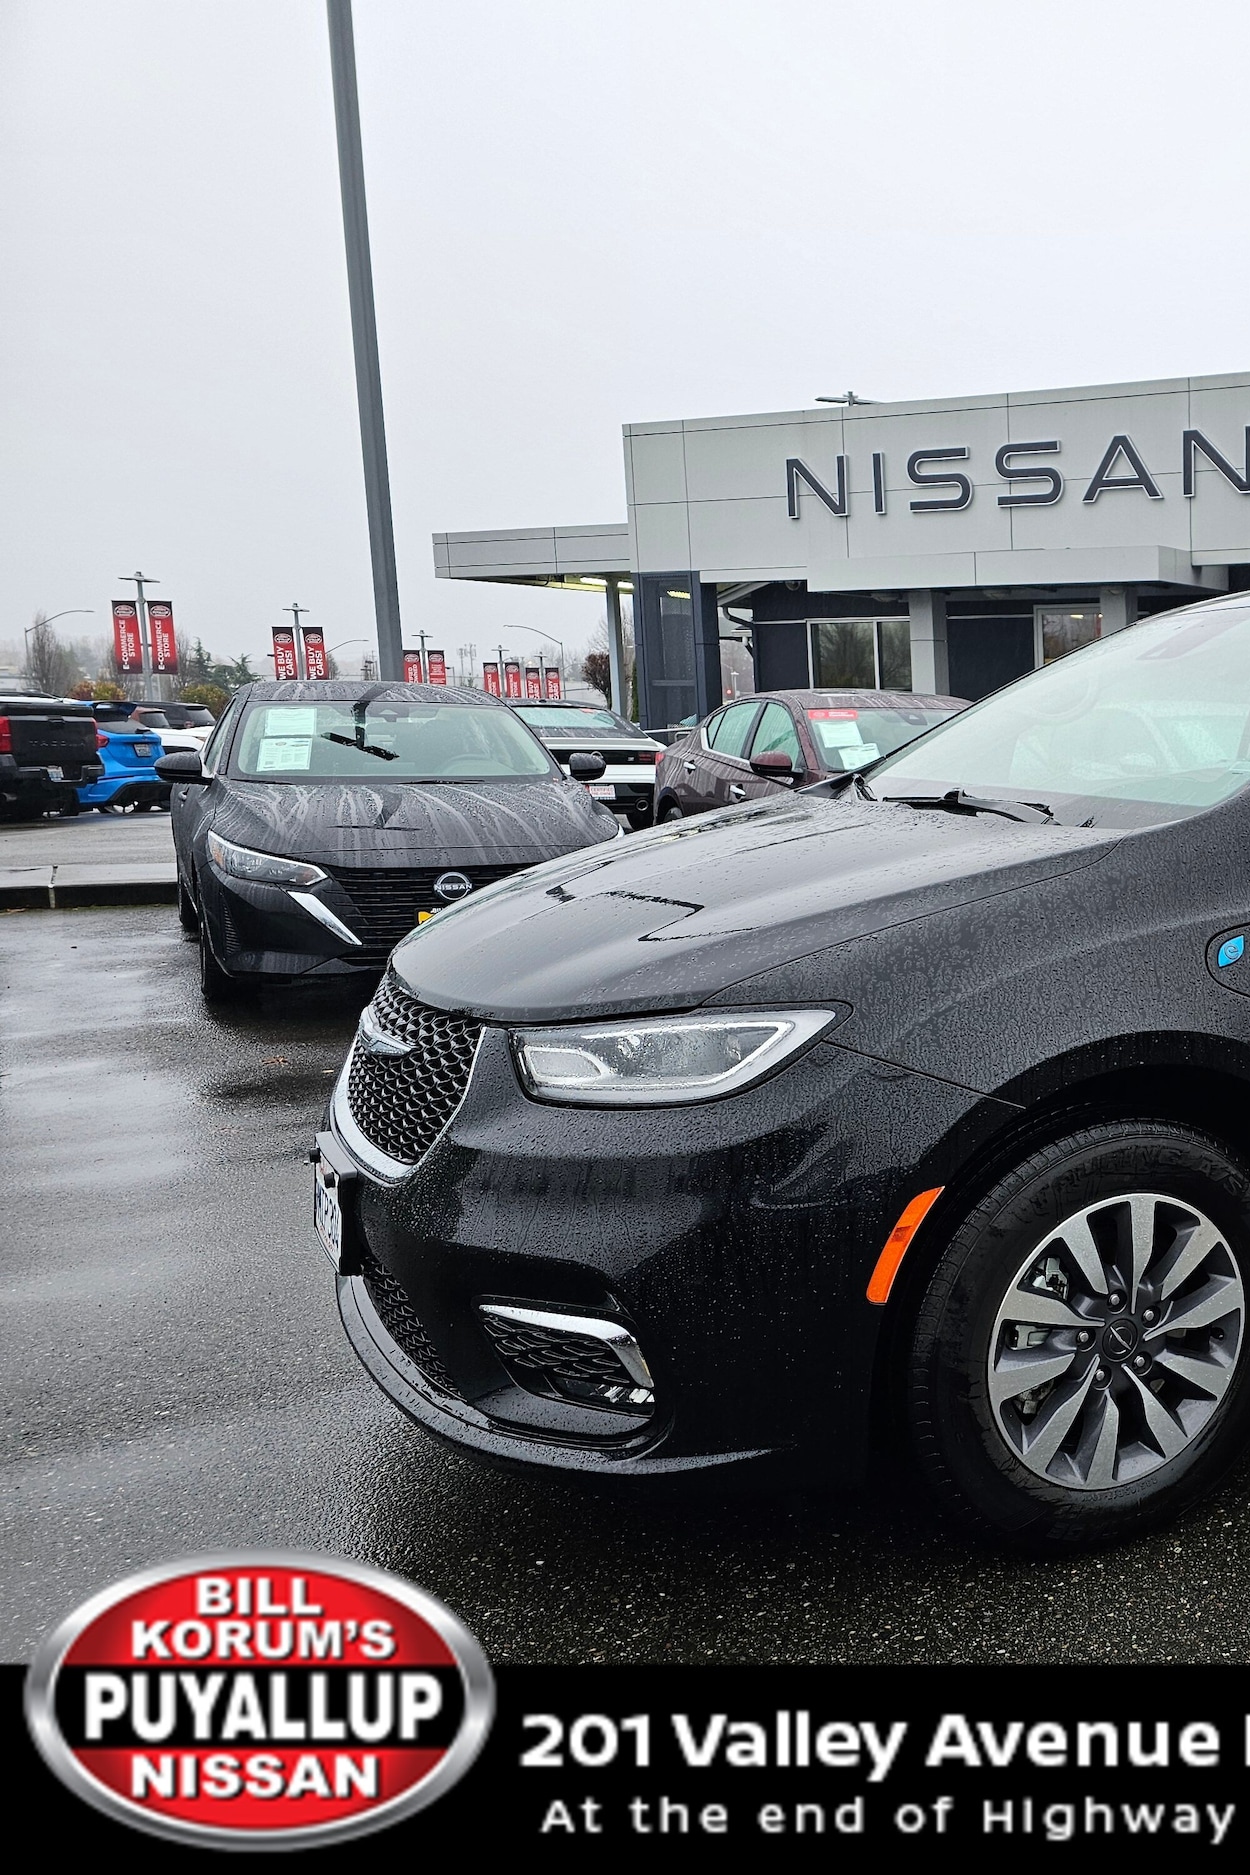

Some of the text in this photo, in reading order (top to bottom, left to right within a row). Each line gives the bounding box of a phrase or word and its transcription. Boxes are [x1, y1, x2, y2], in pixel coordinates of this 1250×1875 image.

[119, 620, 130, 670] E-COMMERCE
[127, 633, 135, 657] STORE
[155, 620, 165, 670] E-COMMERCE
[162, 633, 171, 657] STORE
[276, 646, 285, 664] BUY
[307, 646, 315, 664] BUY
[278, 666, 286, 680] WE
[285, 650, 294, 676] CARS!
[309, 666, 317, 680] WE
[315, 650, 324, 676] CARS!
[434, 883, 472, 891] NISSAN
